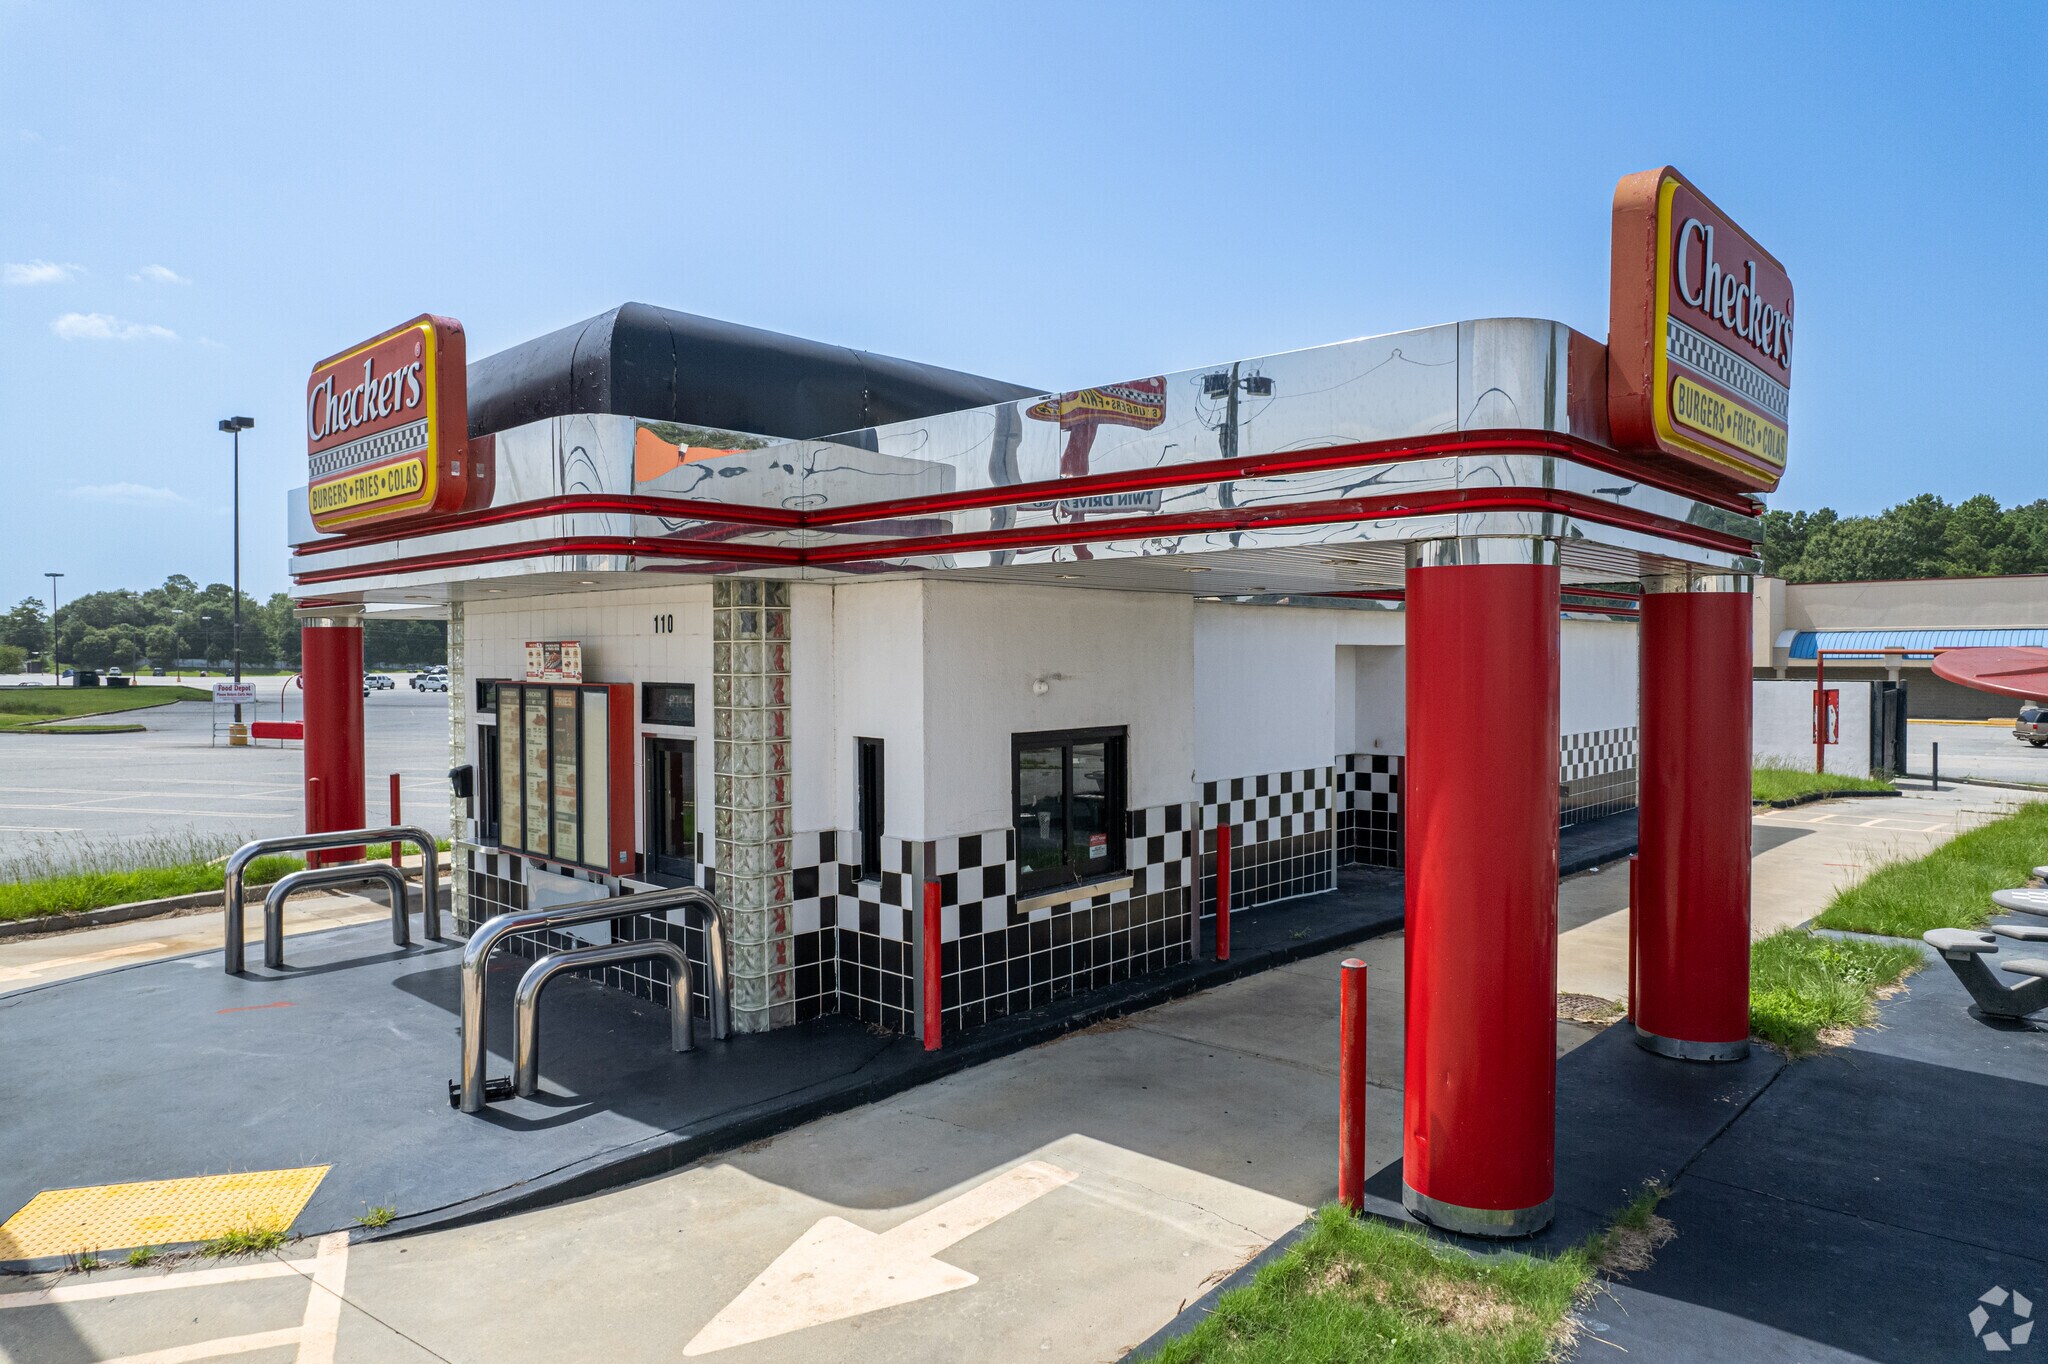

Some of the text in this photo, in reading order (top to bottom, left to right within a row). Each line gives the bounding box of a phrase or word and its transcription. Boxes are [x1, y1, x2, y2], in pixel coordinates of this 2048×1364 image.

[1677, 217, 1793, 370] Checkers
[308, 356, 422, 441] Checkers
[1678, 382, 1787, 462] BURGERS FRIES COLAS
[312, 464, 418, 510] BURGERS FRIES COLAS
[653, 614, 674, 634] 110
